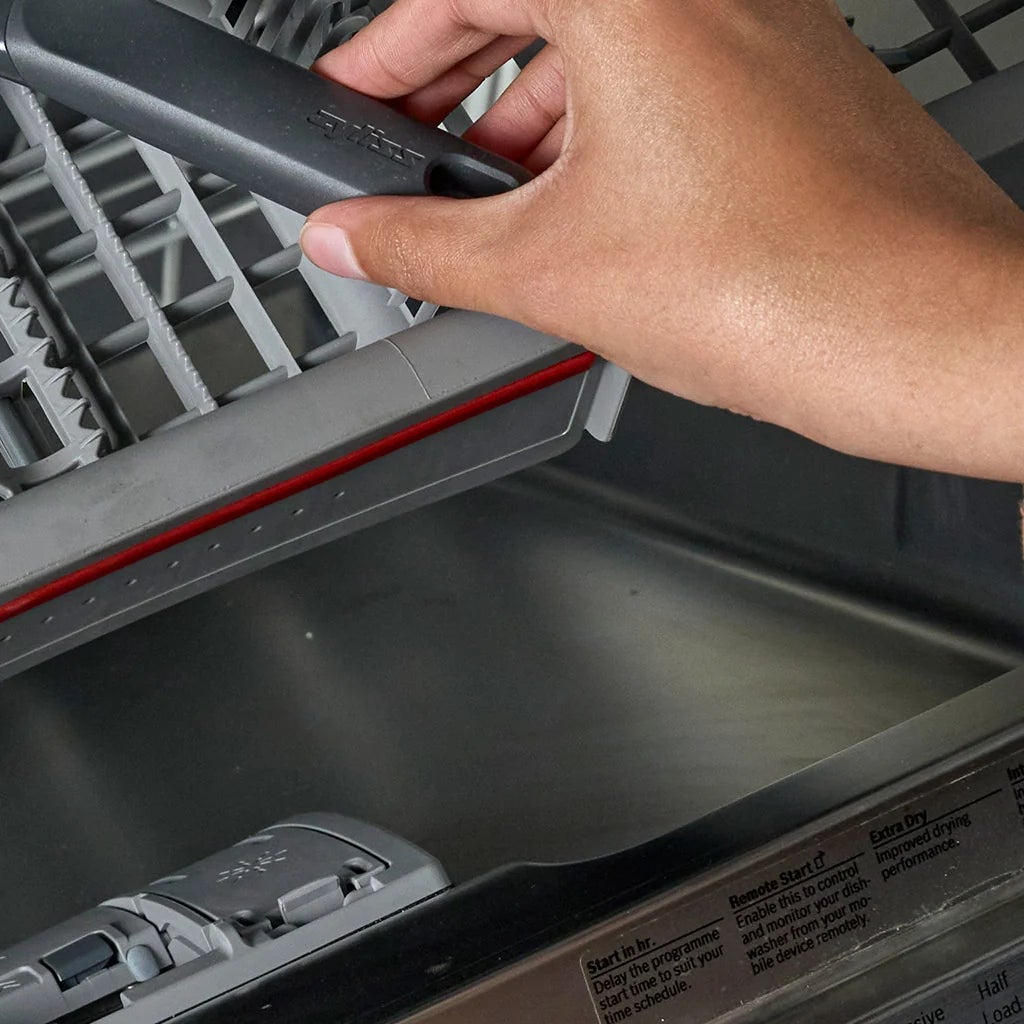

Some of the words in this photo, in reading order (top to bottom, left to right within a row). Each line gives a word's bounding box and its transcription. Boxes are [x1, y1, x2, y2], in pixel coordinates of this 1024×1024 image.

[869, 822, 904, 845] Extra
[903, 809, 927, 827] Dry
[932, 812, 972, 838] drying
[881, 837, 960, 881] performance.
[728, 879, 779, 909] Remote
[779, 861, 814, 885] Start
[735, 902, 777, 928] Enable
[778, 891, 802, 909] this
[803, 884, 816, 898] to
[817, 862, 859, 891] control
[742, 924, 765, 945] and
[767, 905, 812, 933] monitor
[813, 890, 840, 914] your
[842, 877, 871, 898] dish-
[746, 931, 789, 960] washer
[790, 919, 820, 939] from
[820, 905, 846, 929] your
[849, 896, 872, 913] mo-
[586, 950, 623, 975] Start
[621, 944, 636, 959] in
[636, 936, 656, 952] hr.
[593, 971, 627, 995] Delay
[629, 962, 650, 978] the
[651, 929, 720, 971] programme
[750, 956, 775, 976] bile
[776, 938, 815, 964] device
[816, 914, 870, 945] remotely.
[599, 988, 629, 1011] start
[629, 976, 657, 997] time
[659, 969, 672, 983] to
[675, 959, 697, 977] suit
[697, 944, 724, 969] your
[977, 970, 1009, 1000] Half
[604, 1005, 633, 1024] time
[634, 980, 692, 1013] schedule.
